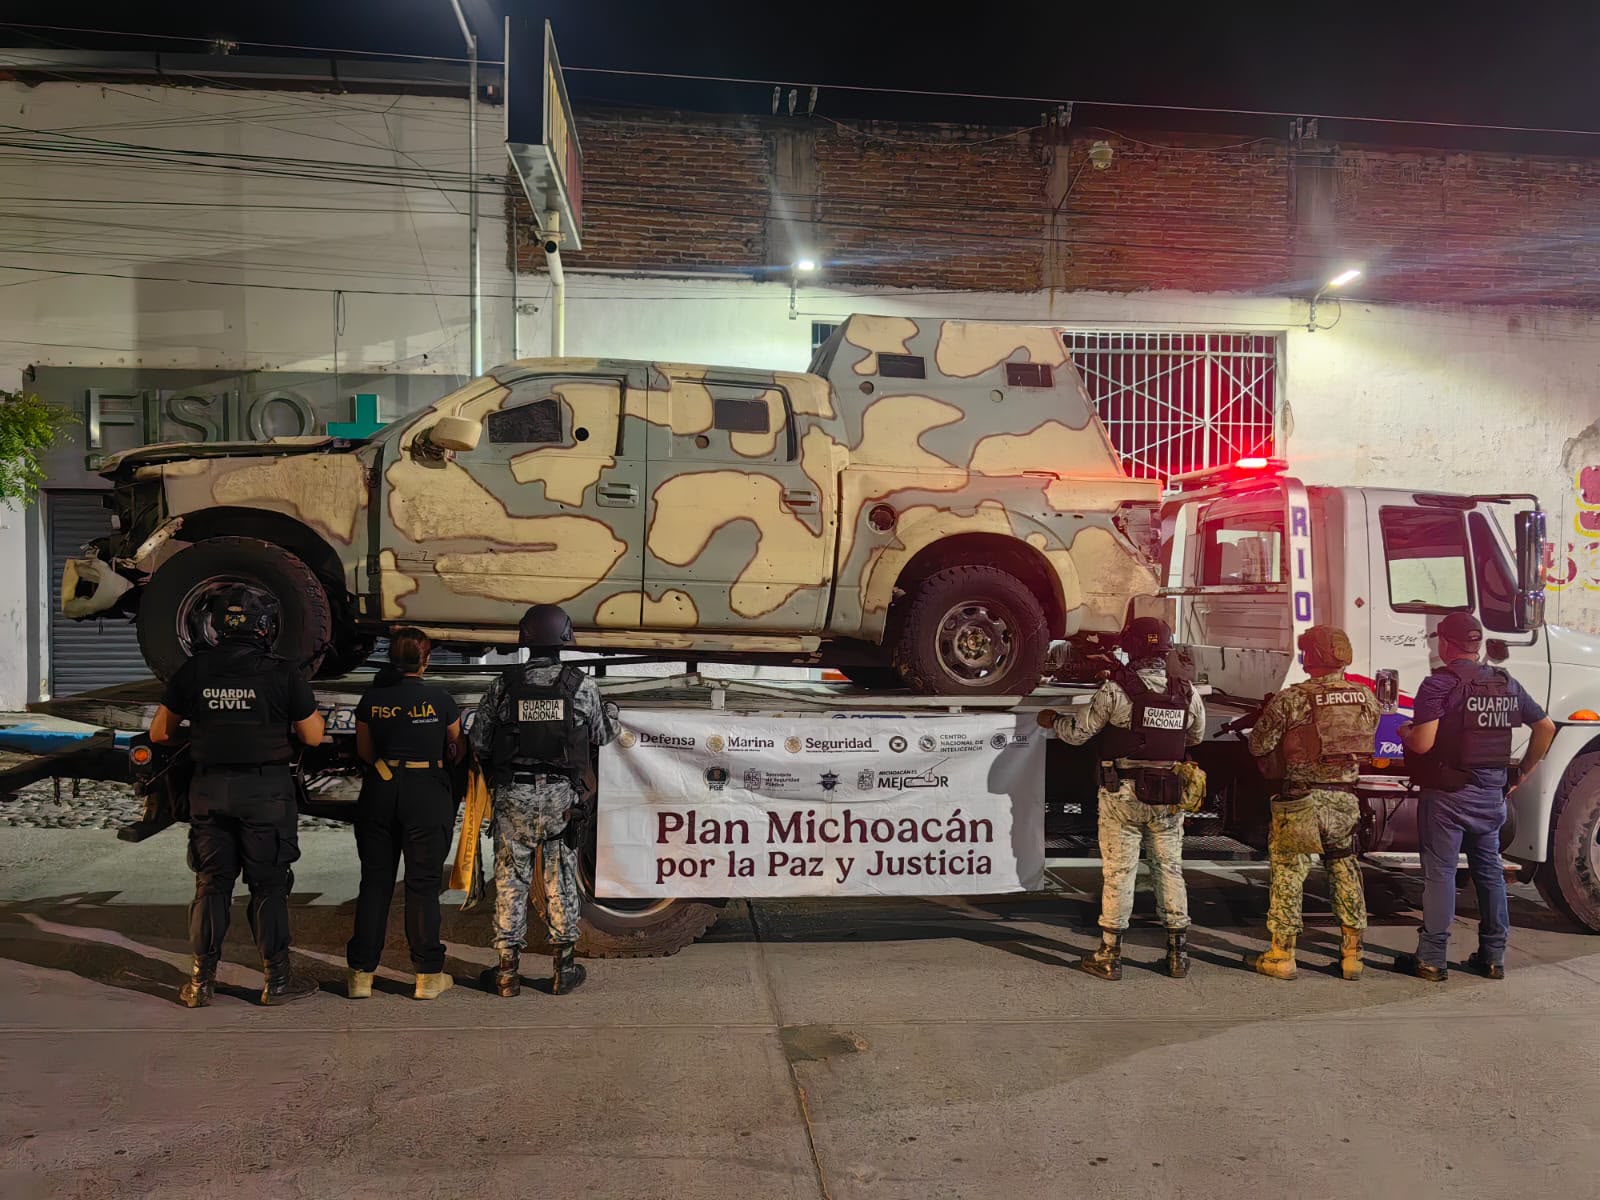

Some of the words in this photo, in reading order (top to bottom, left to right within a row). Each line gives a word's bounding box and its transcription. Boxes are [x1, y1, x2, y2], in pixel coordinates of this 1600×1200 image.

[86, 388, 315, 450] FISIO
[202, 688, 257, 699] GUARDIA
[1315, 691, 1366, 705] EJERCITO
[208, 699, 251, 710] CIVIL
[522, 700, 560, 711] GUARDIA
[1466, 696, 1519, 712] GUARDIA
[522, 710, 561, 721] NACIONAL
[1147, 708, 1182, 719] GUARDIA
[1477, 712, 1511, 727] CIVIL
[1143, 717, 1184, 728] NACIONAL
[639, 732, 696, 746] Defensa
[727, 735, 775, 748] Marina
[806, 737, 873, 751] Seguridad
[655, 810, 751, 844] Plan
[766, 808, 994, 844] Michoacán
[655, 856, 716, 885] por
[727, 850, 756, 877] la
[767, 851, 824, 877] Paz
[835, 857, 855, 884] y
[866, 849, 992, 876] Justicia
